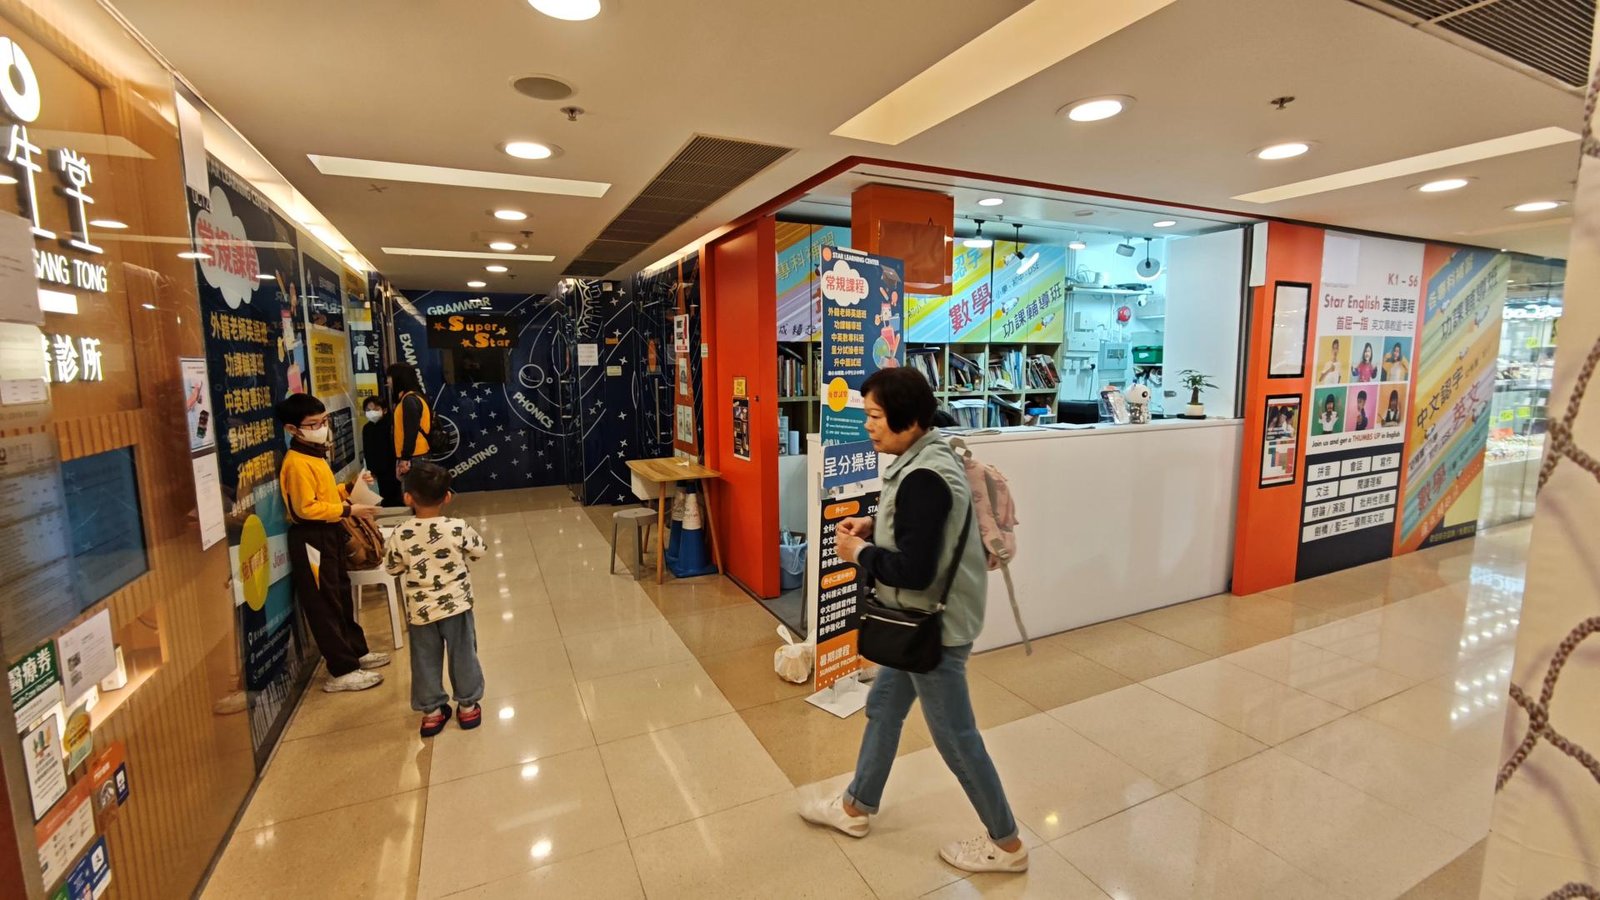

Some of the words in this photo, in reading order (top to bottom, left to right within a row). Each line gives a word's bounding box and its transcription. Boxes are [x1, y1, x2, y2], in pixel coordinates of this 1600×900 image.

[844, 253, 864, 263] LEARNING
[865, 258, 880, 266] CENTER
[73, 259, 108, 293] TONG
[826, 274, 865, 294] 常規課程
[1387, 272, 1399, 286] K1
[1408, 274, 1418, 287] S6
[427, 297, 491, 315] GRAMMAR
[949, 282, 992, 335] 數學
[1002, 282, 1062, 339] 功課輔導班
[1324, 294, 1345, 308] Star
[1347, 294, 1380, 313] English
[1382, 298, 1415, 314] 英語課程
[1336, 315, 1368, 331] 首屈一指
[400, 333, 417, 366] EXAM
[1417, 366, 1463, 428] 中文認字
[513, 391, 554, 429] PHONICS
[449, 444, 498, 479] DEBATING
[824, 451, 877, 478] 呈分操卷
[1316, 485, 1329, 498] 文法
[867, 505, 878, 514] STA
[823, 523, 837, 534] 全科
[822, 535, 838, 546] 中文
[8, 647, 51, 697] 醫療券
